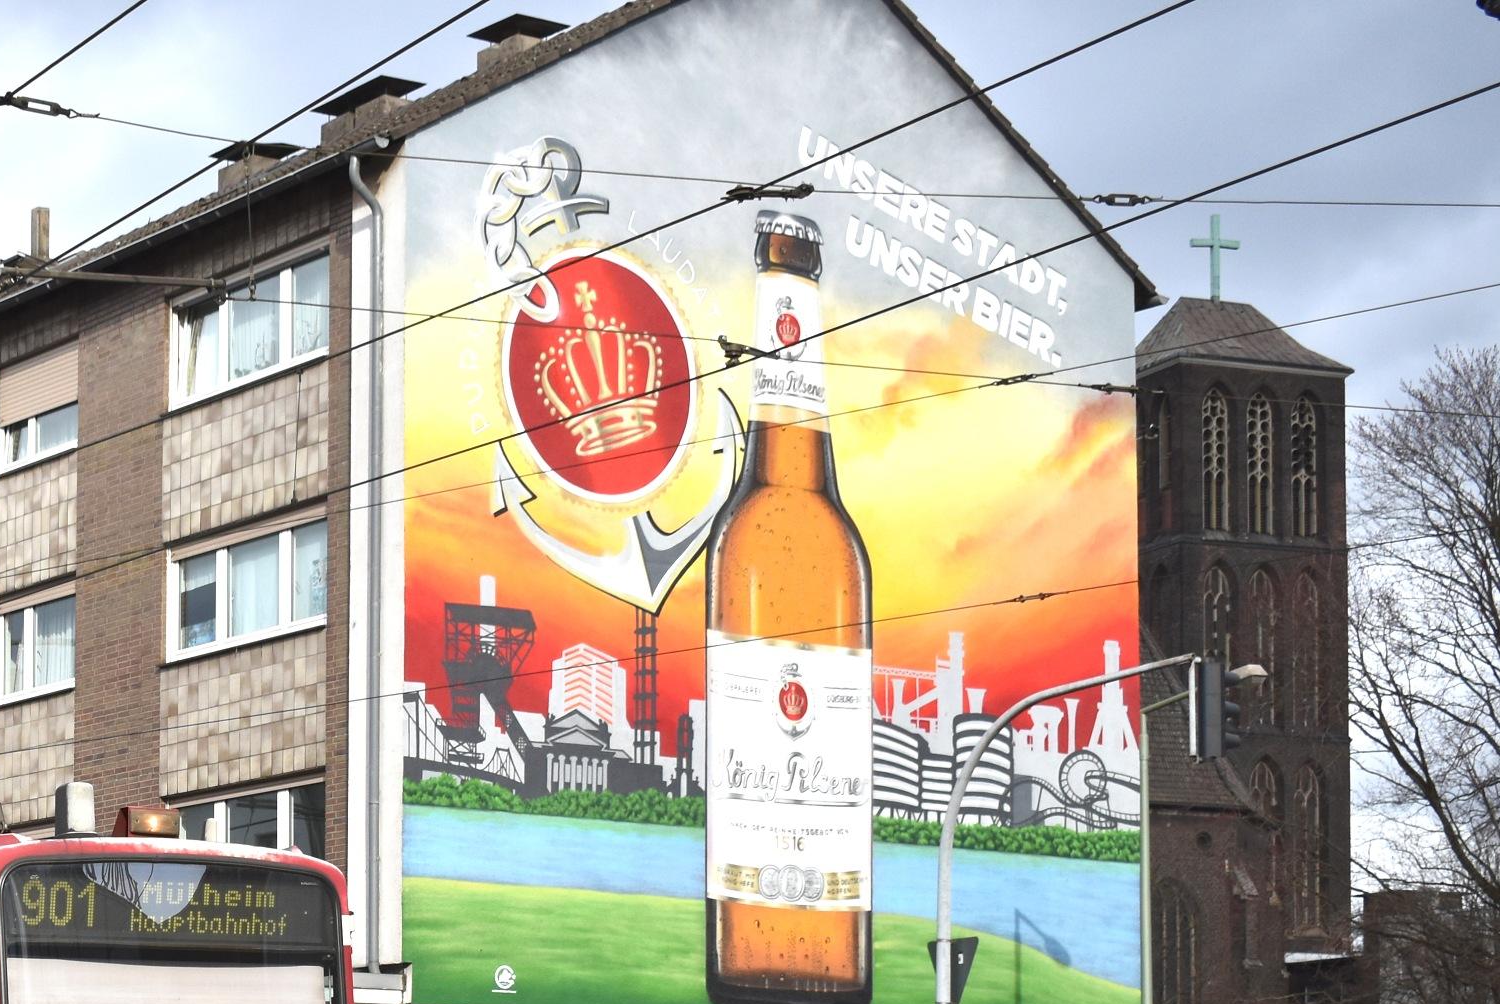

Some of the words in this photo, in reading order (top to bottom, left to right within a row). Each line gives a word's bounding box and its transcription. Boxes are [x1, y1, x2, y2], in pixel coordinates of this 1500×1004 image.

[798, 126, 950, 243] UNSERE
[951, 218, 1069, 316] STADT,
[845, 215, 973, 317] UNSER
[972, 286, 1063, 368] BIER.
[754, 368, 785, 395] König
[712, 748, 780, 801] König
[781, 751, 869, 796] Pilsener
[775, 835, 805, 852] 1516
[20, 879, 97, 928] 901
[142, 881, 276, 909] Mülheim
[130, 908, 288, 937] Hauptbahnhof
